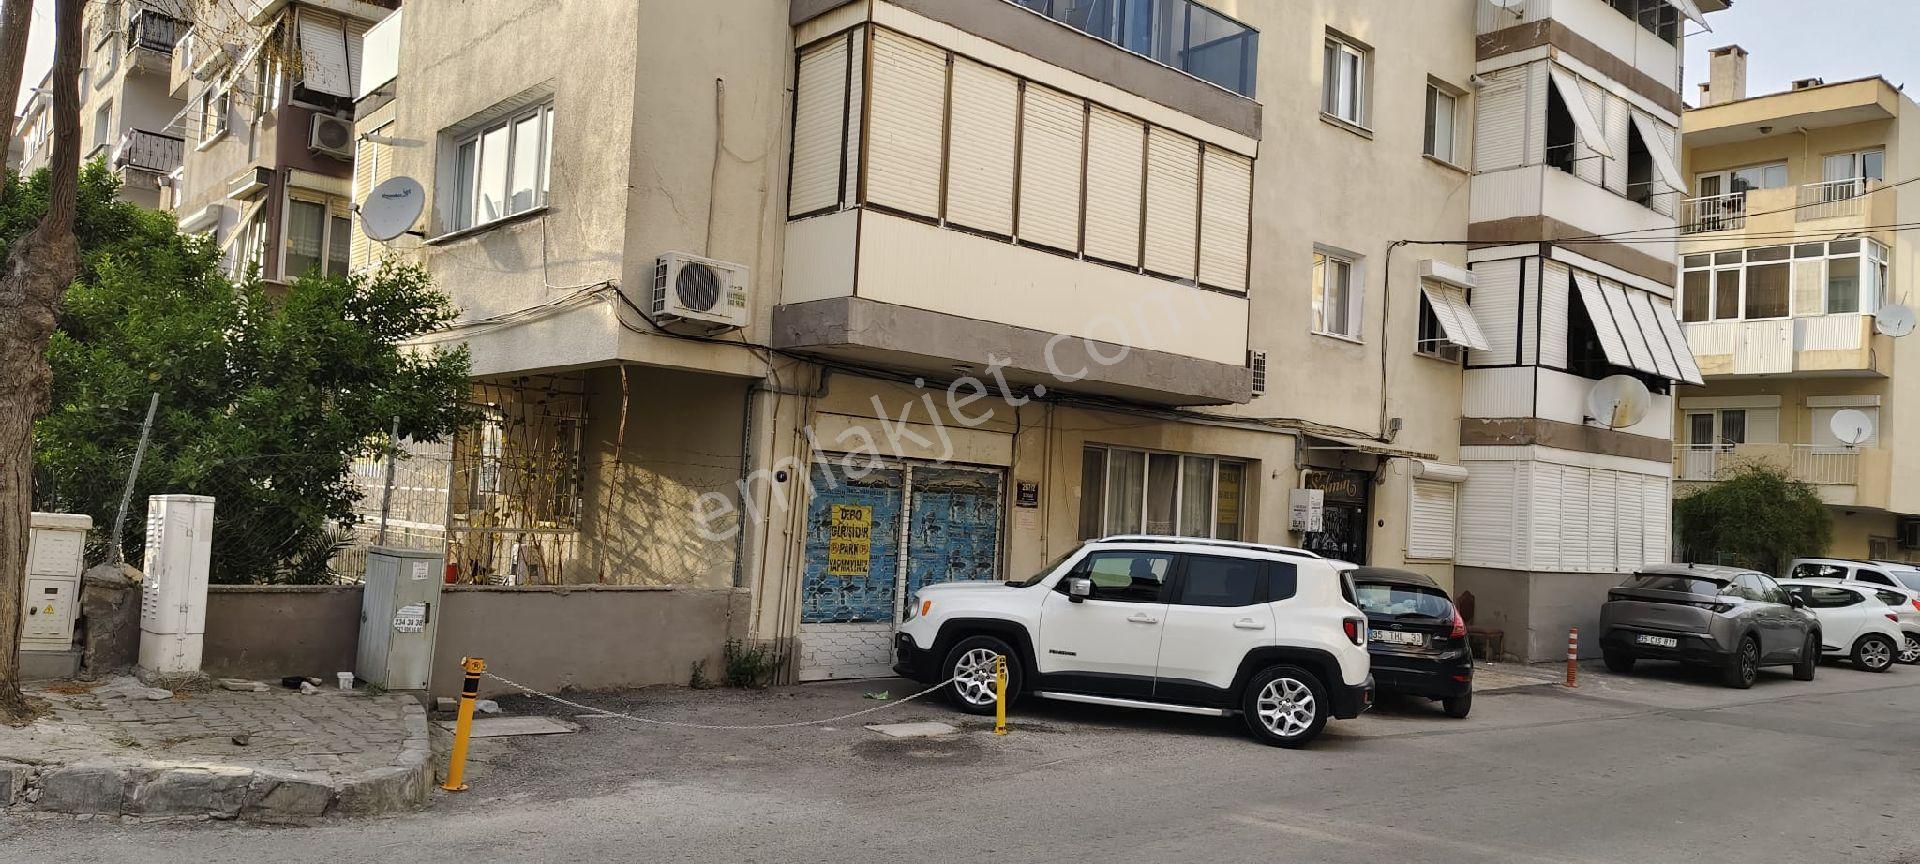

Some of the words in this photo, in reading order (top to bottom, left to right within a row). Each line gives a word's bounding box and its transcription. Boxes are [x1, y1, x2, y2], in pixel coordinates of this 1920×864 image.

[840, 508, 863, 521] DEPO
[839, 543, 860, 555] PARK
[1372, 630, 1383, 639] 35
